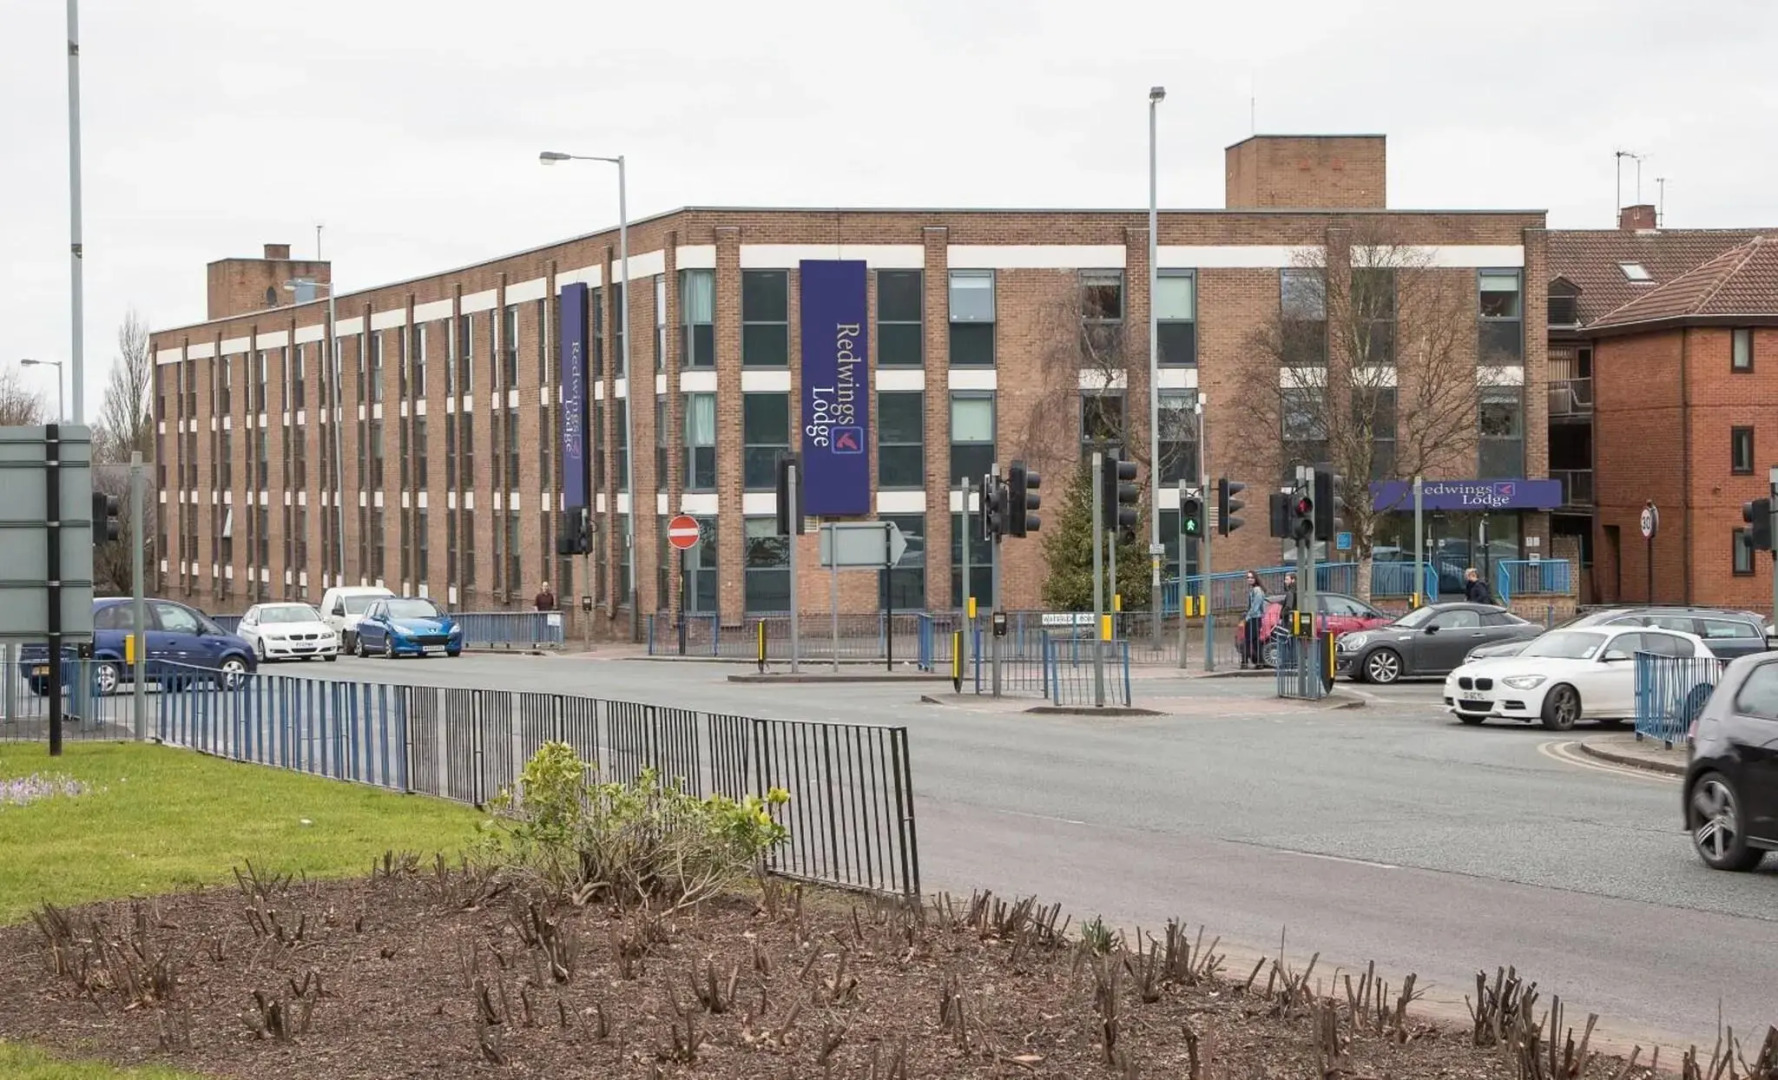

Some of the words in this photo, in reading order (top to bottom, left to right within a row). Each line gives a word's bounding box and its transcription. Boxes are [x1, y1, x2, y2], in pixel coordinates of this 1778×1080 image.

[571, 342, 581, 433] Redwings
[830, 323, 862, 425] Redwings
[564, 400, 573, 453] Lodge
[806, 386, 836, 447] Lodge
[1413, 483, 1493, 497] edwings
[1462, 494, 1510, 507] Lodge
[1642, 516, 1650, 530] 30
